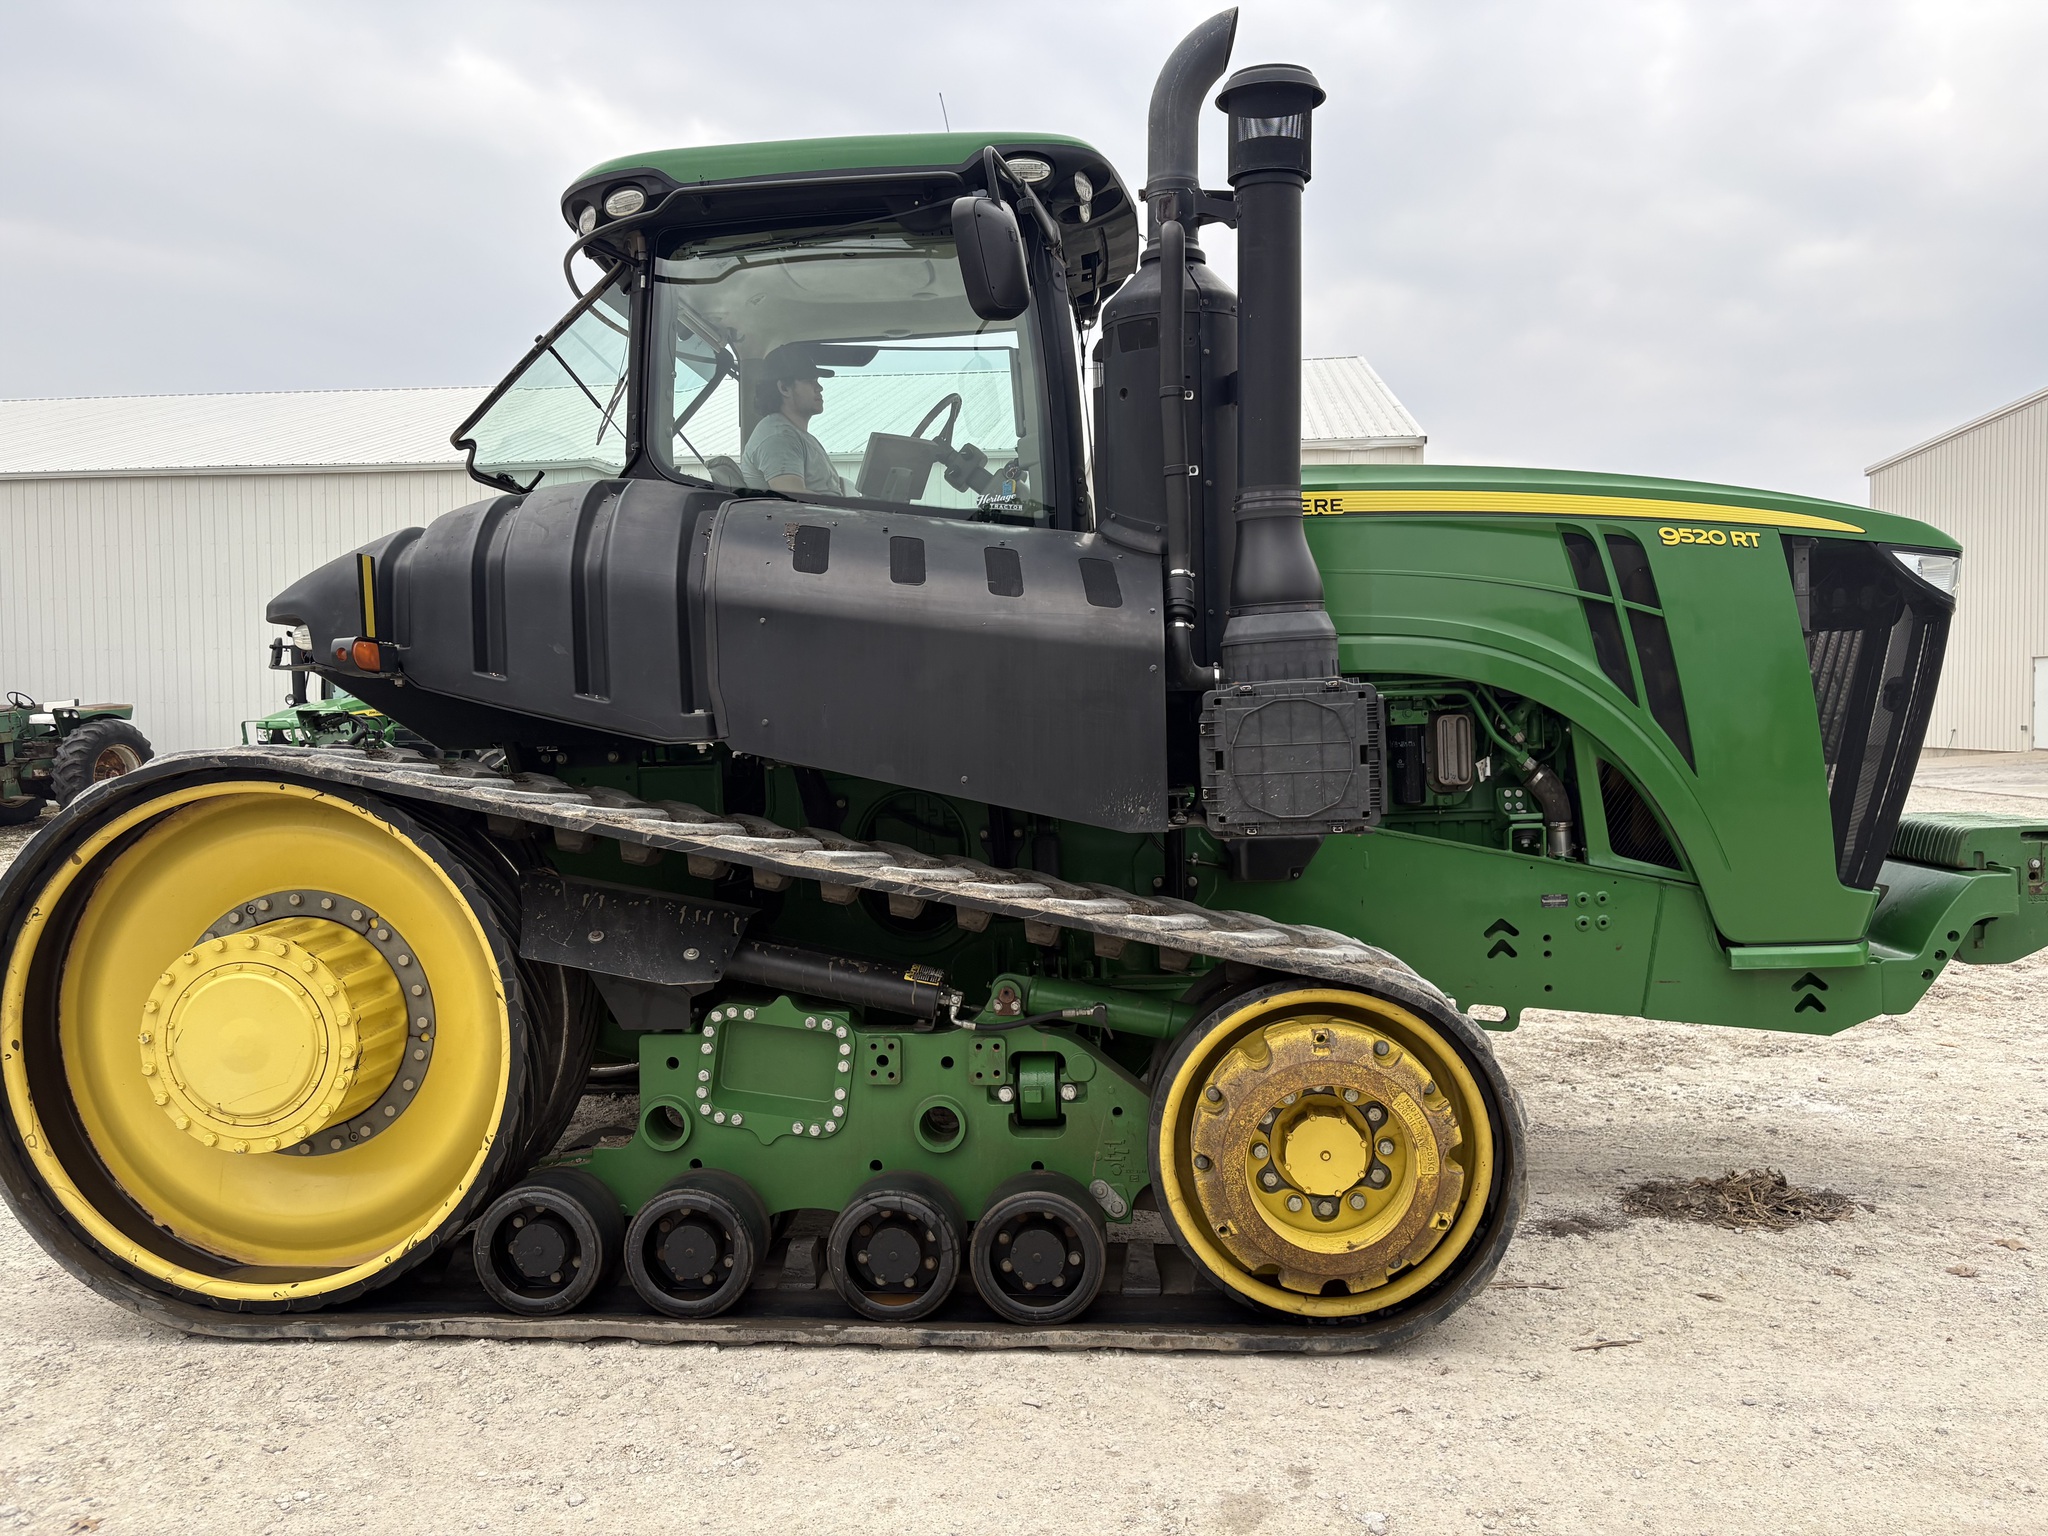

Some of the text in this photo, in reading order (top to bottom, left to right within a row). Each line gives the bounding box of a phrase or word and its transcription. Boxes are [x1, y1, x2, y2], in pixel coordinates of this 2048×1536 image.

[977, 493, 1017, 506] Heritage
[990, 503, 1023, 511] TRACTOR
[1659, 527, 1760, 548] 9520 RT
